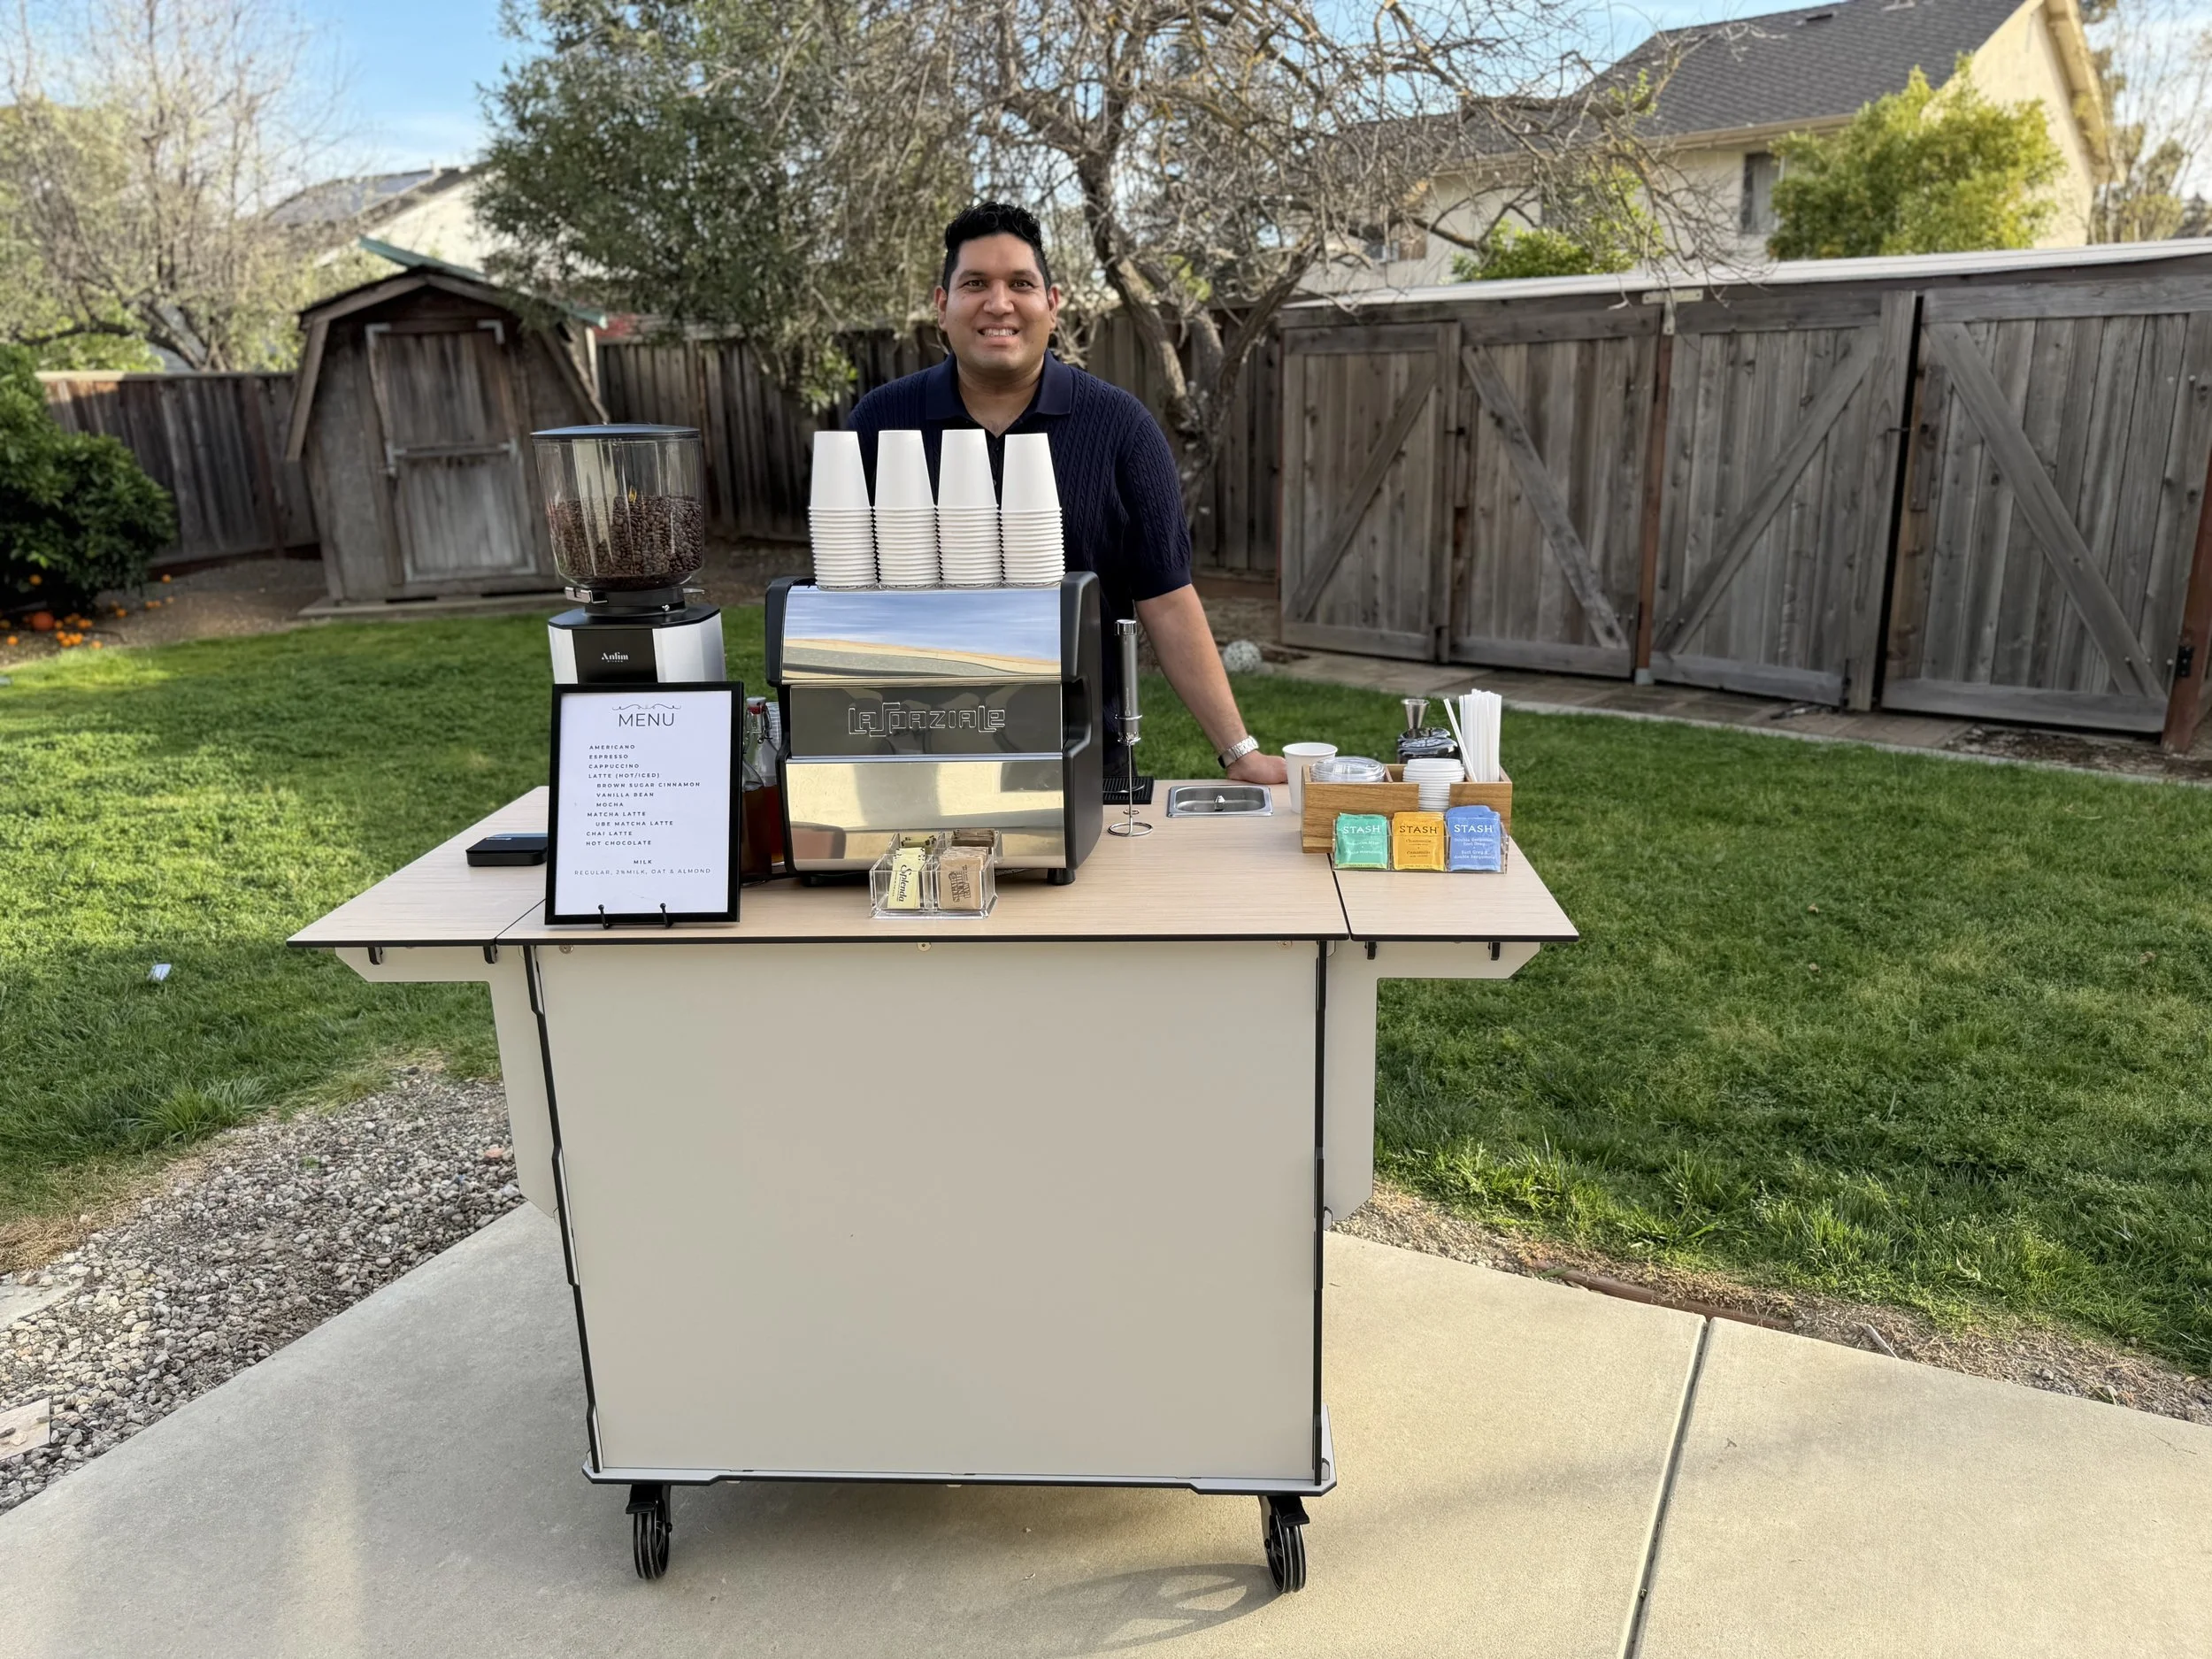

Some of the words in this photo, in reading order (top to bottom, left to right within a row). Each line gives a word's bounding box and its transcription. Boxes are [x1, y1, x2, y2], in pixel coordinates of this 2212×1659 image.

[602, 651, 628, 660] Anlim
[618, 712, 674, 727] MENU
[1343, 825, 1380, 833] STASH
[1454, 825, 1493, 833] STASH
[899, 864, 911, 902] Splenda
[963, 882, 972, 899] RAW
